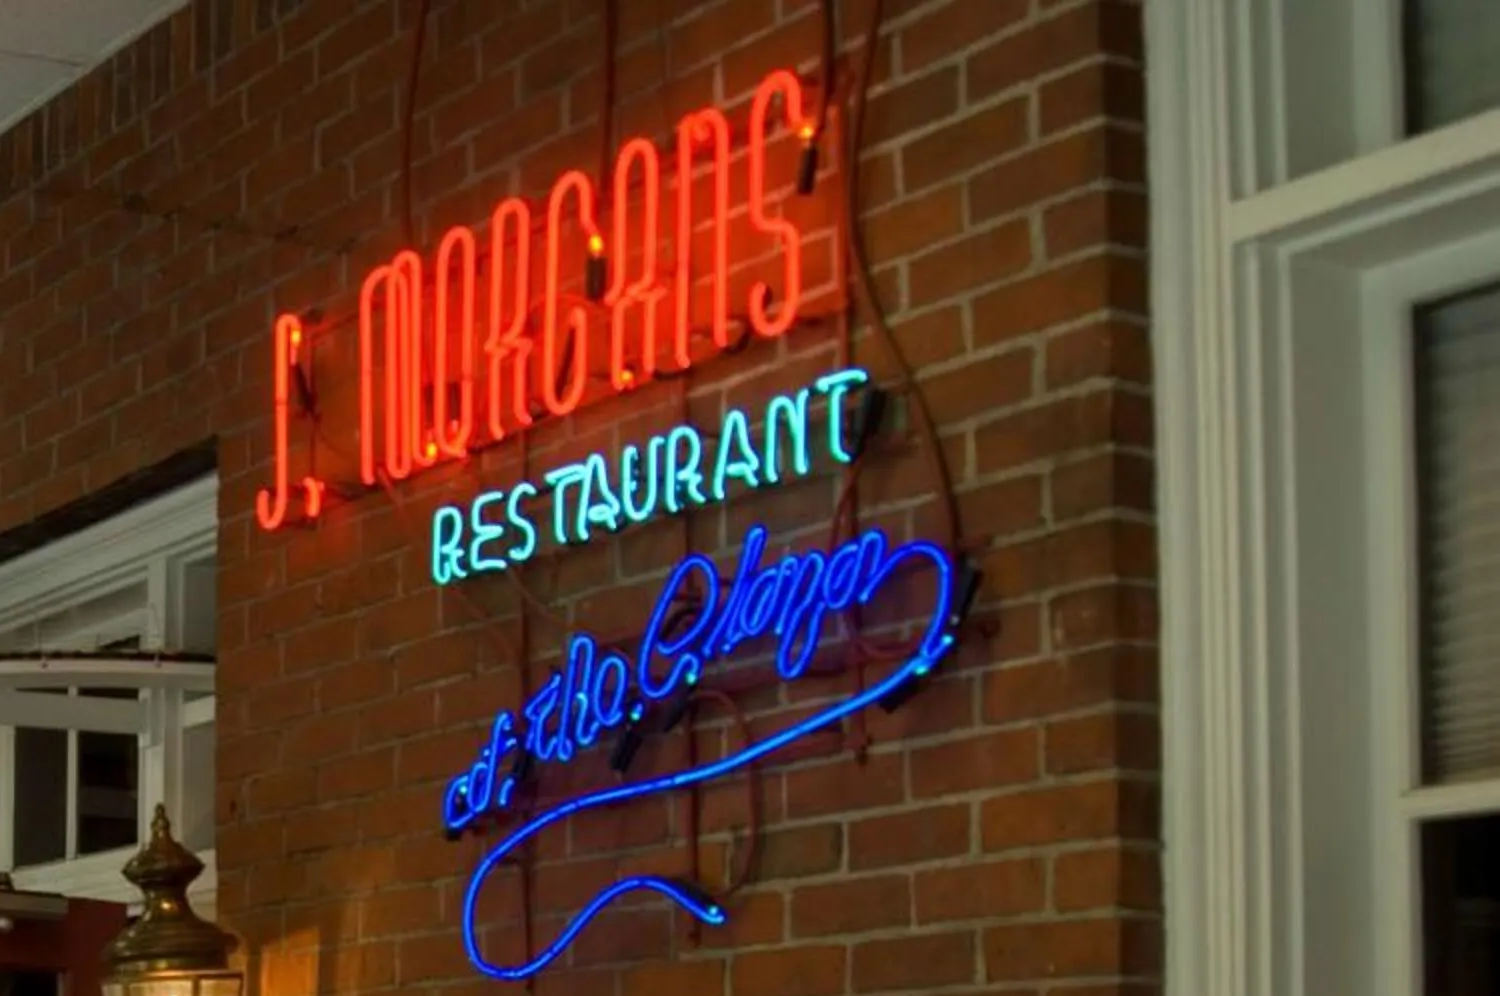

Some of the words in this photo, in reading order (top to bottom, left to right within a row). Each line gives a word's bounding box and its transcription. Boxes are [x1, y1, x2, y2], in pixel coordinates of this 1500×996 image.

[431, 368, 867, 584] RESTAURANT
[443, 709, 518, 830] at
[525, 632, 643, 762] the
